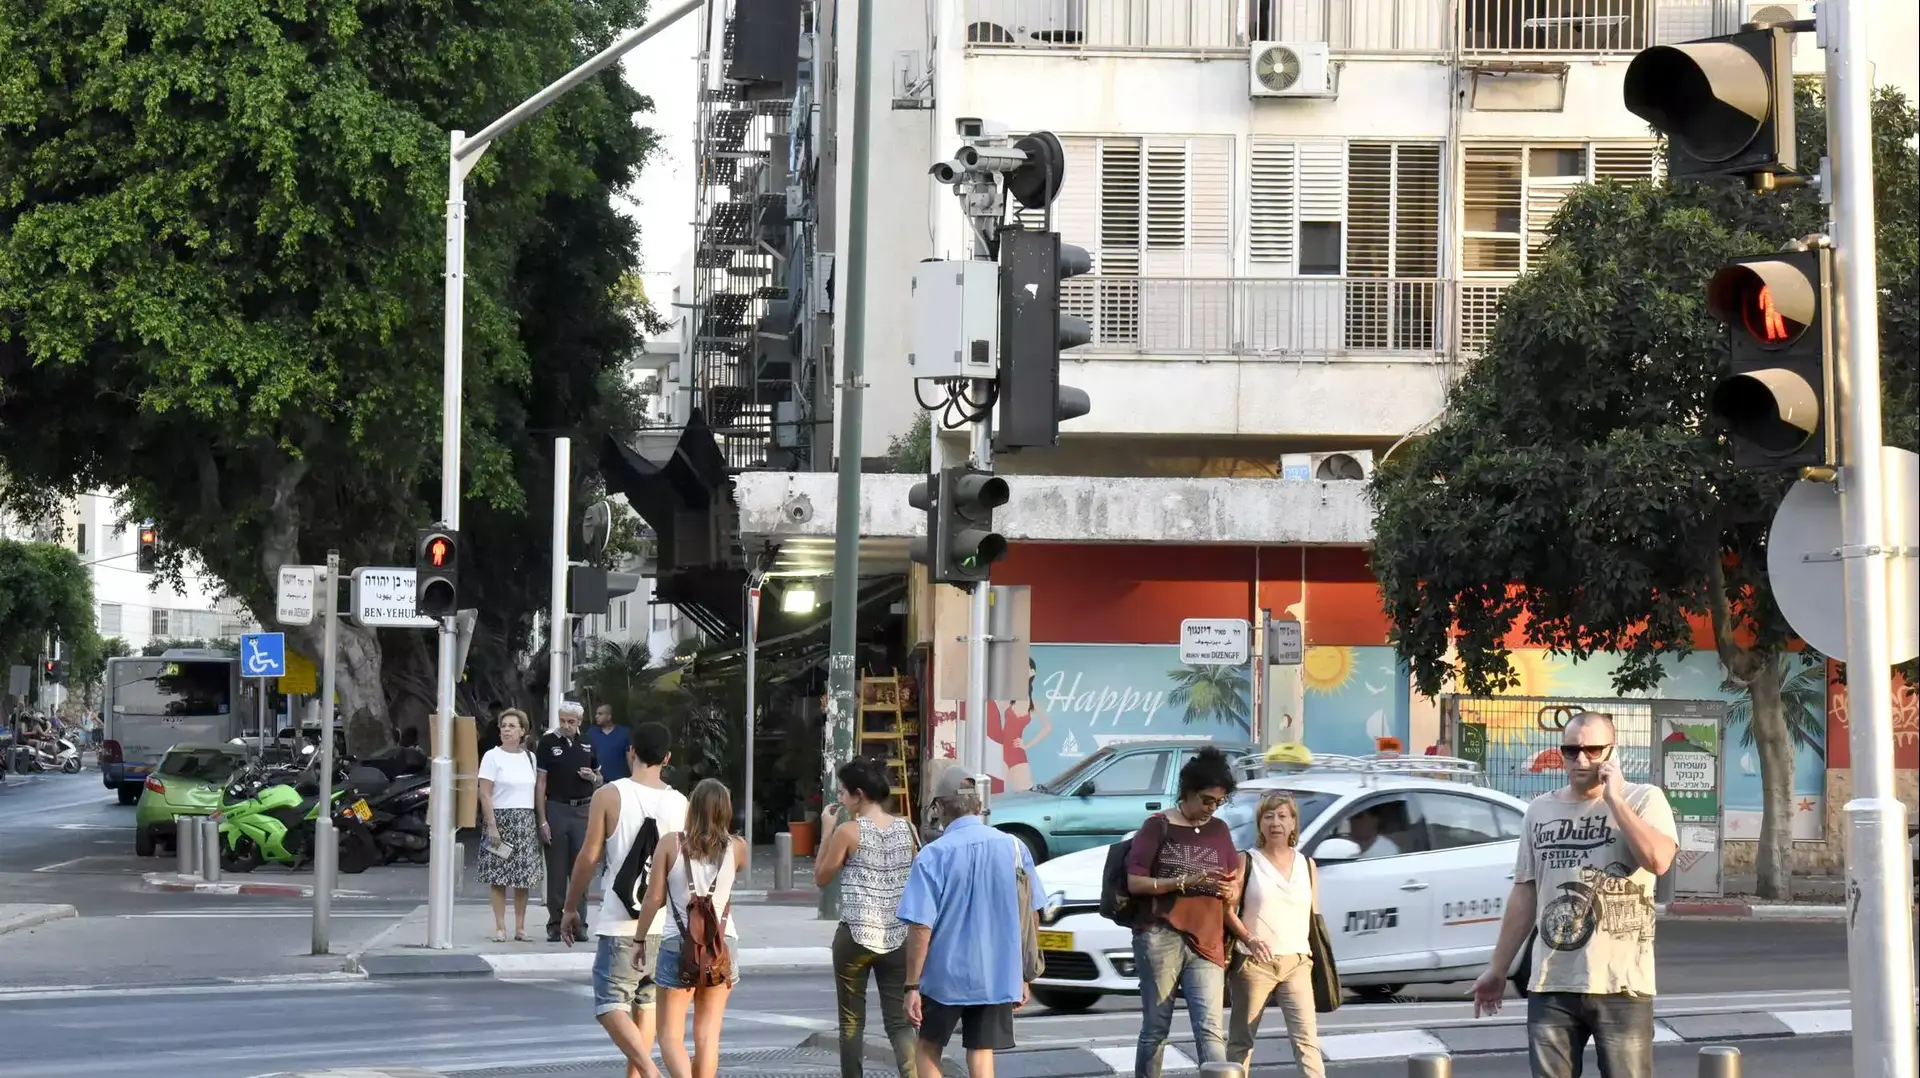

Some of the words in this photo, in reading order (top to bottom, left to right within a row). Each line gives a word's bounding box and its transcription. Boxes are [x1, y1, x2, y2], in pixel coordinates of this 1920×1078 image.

[365, 575, 390, 587] יהודה
[392, 575, 401, 591] בן
[1187, 625, 1212, 637] דיזנגוף
[1043, 670, 1166, 727] Happy
[1673, 761, 1707, 770] משפחת
[1556, 816, 1613, 842] Dutch
